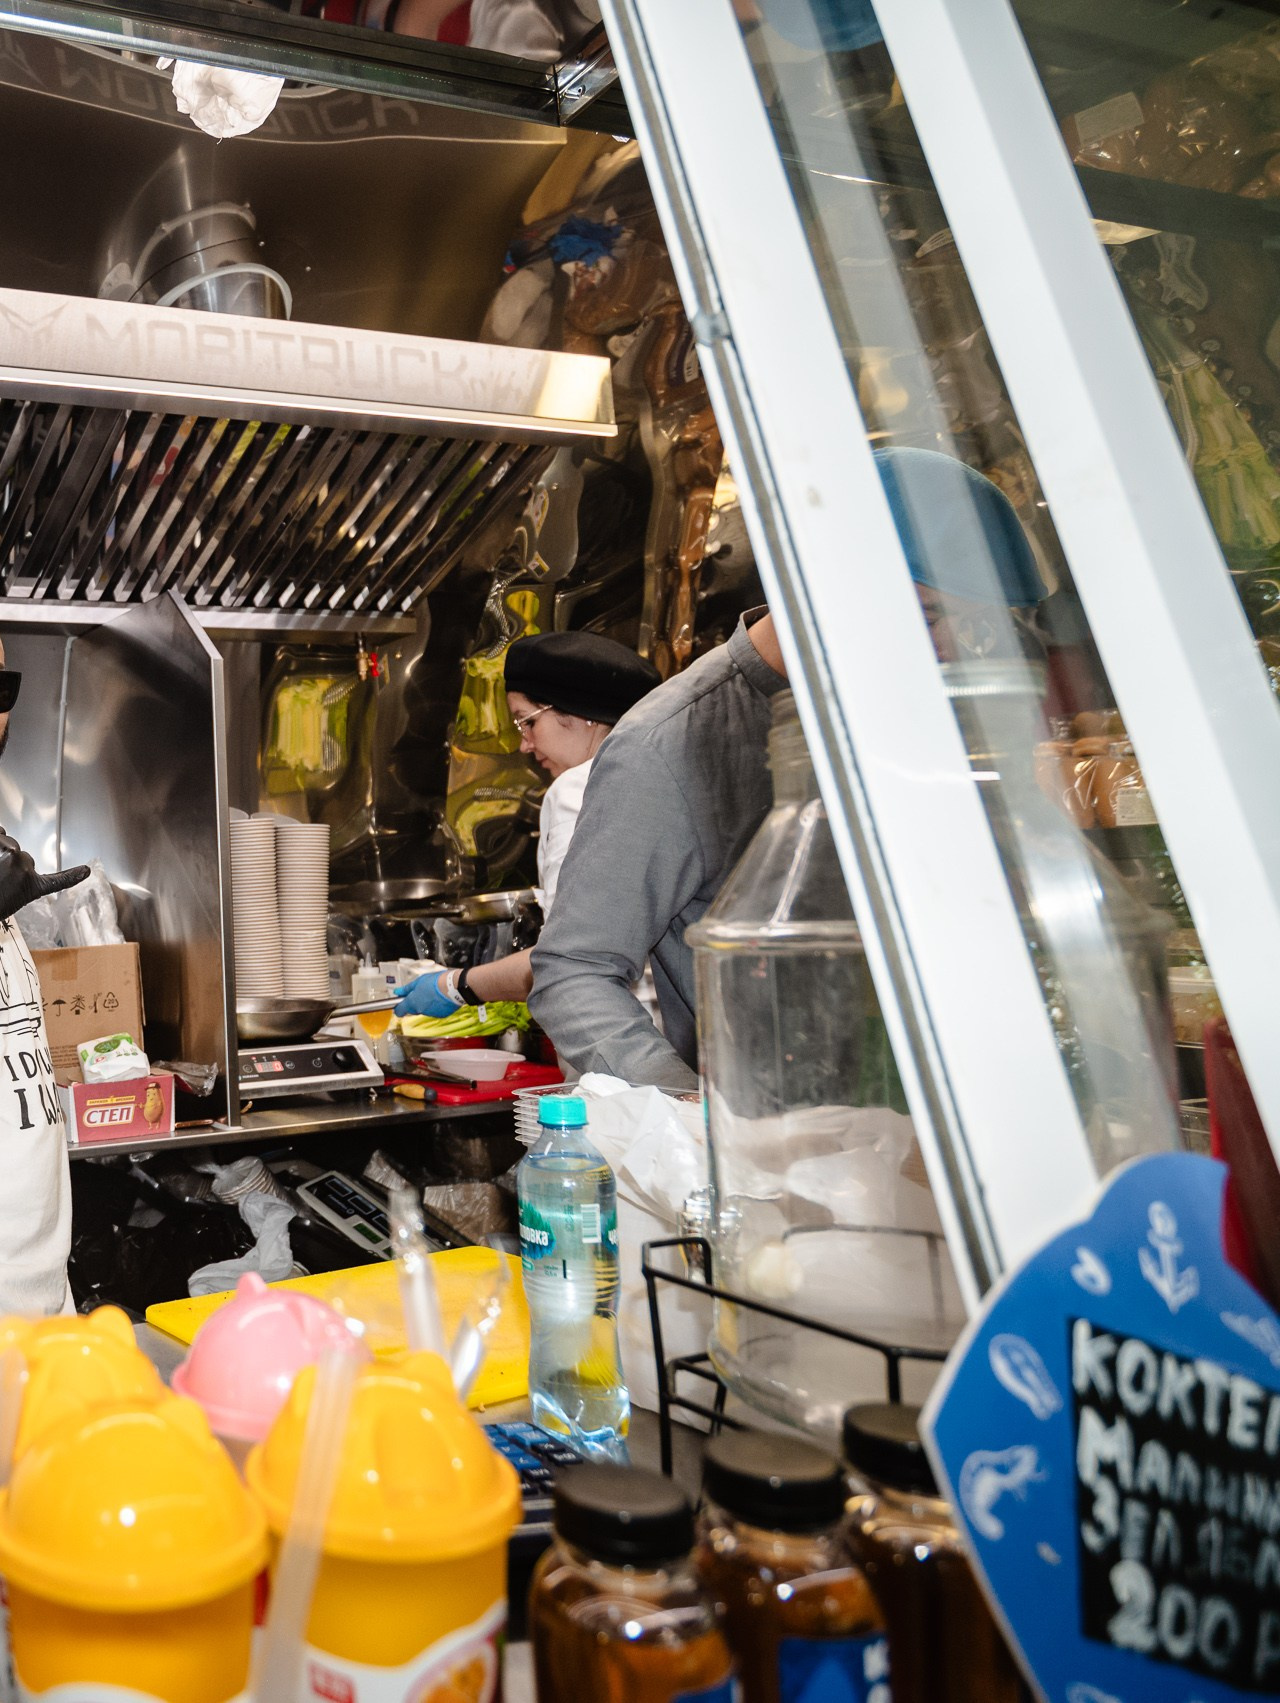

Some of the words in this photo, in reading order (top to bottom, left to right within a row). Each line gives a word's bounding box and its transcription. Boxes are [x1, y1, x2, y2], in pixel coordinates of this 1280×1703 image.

[84, 314, 470, 397] MOBITRUCK
[4, 1055, 20, 1082] I
[13, 1088, 35, 1130] I
[86, 1107, 131, 1124] СТЕП
[1108, 1559, 1240, 1669] 200
